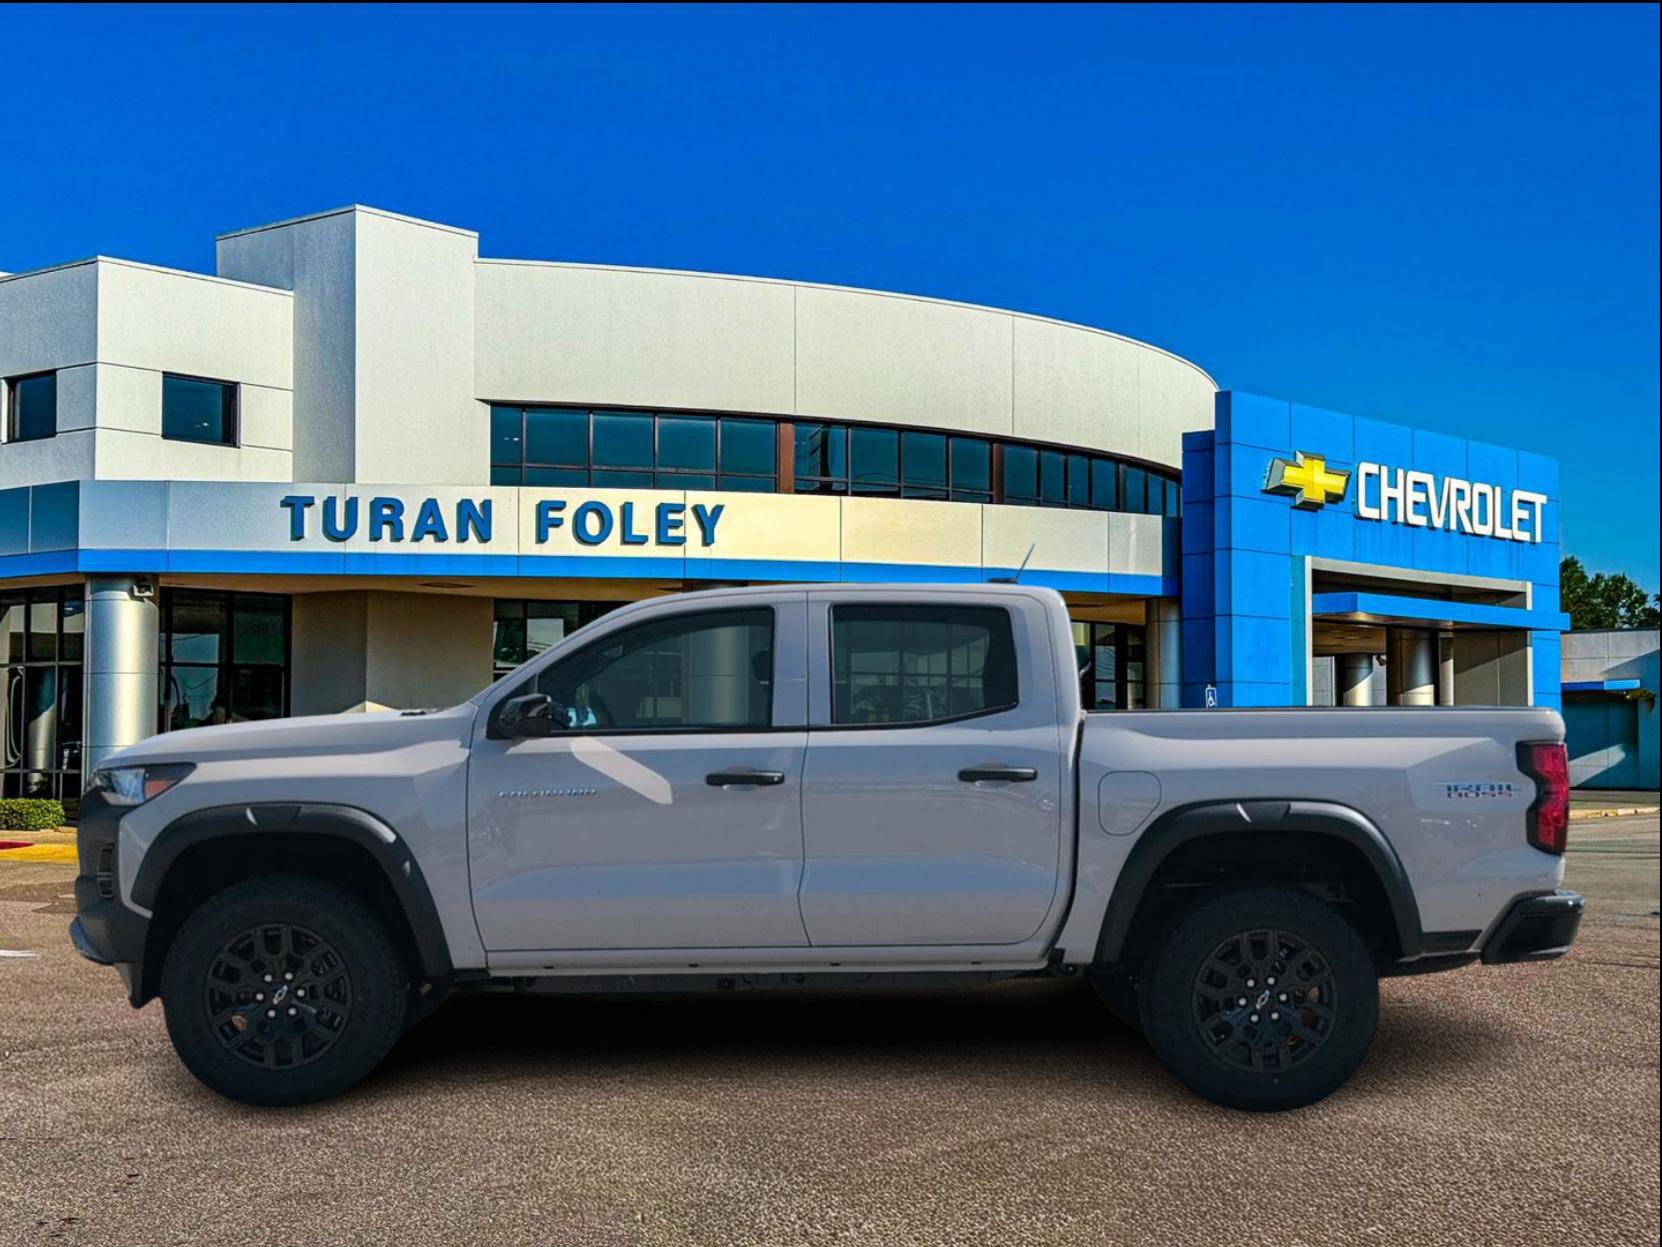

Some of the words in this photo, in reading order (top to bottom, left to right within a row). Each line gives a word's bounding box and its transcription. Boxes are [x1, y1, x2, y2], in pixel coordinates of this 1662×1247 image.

[280, 496, 493, 543] TURAN
[535, 499, 725, 547] FOLEY
[1357, 462, 1547, 543] CHEVROLET
